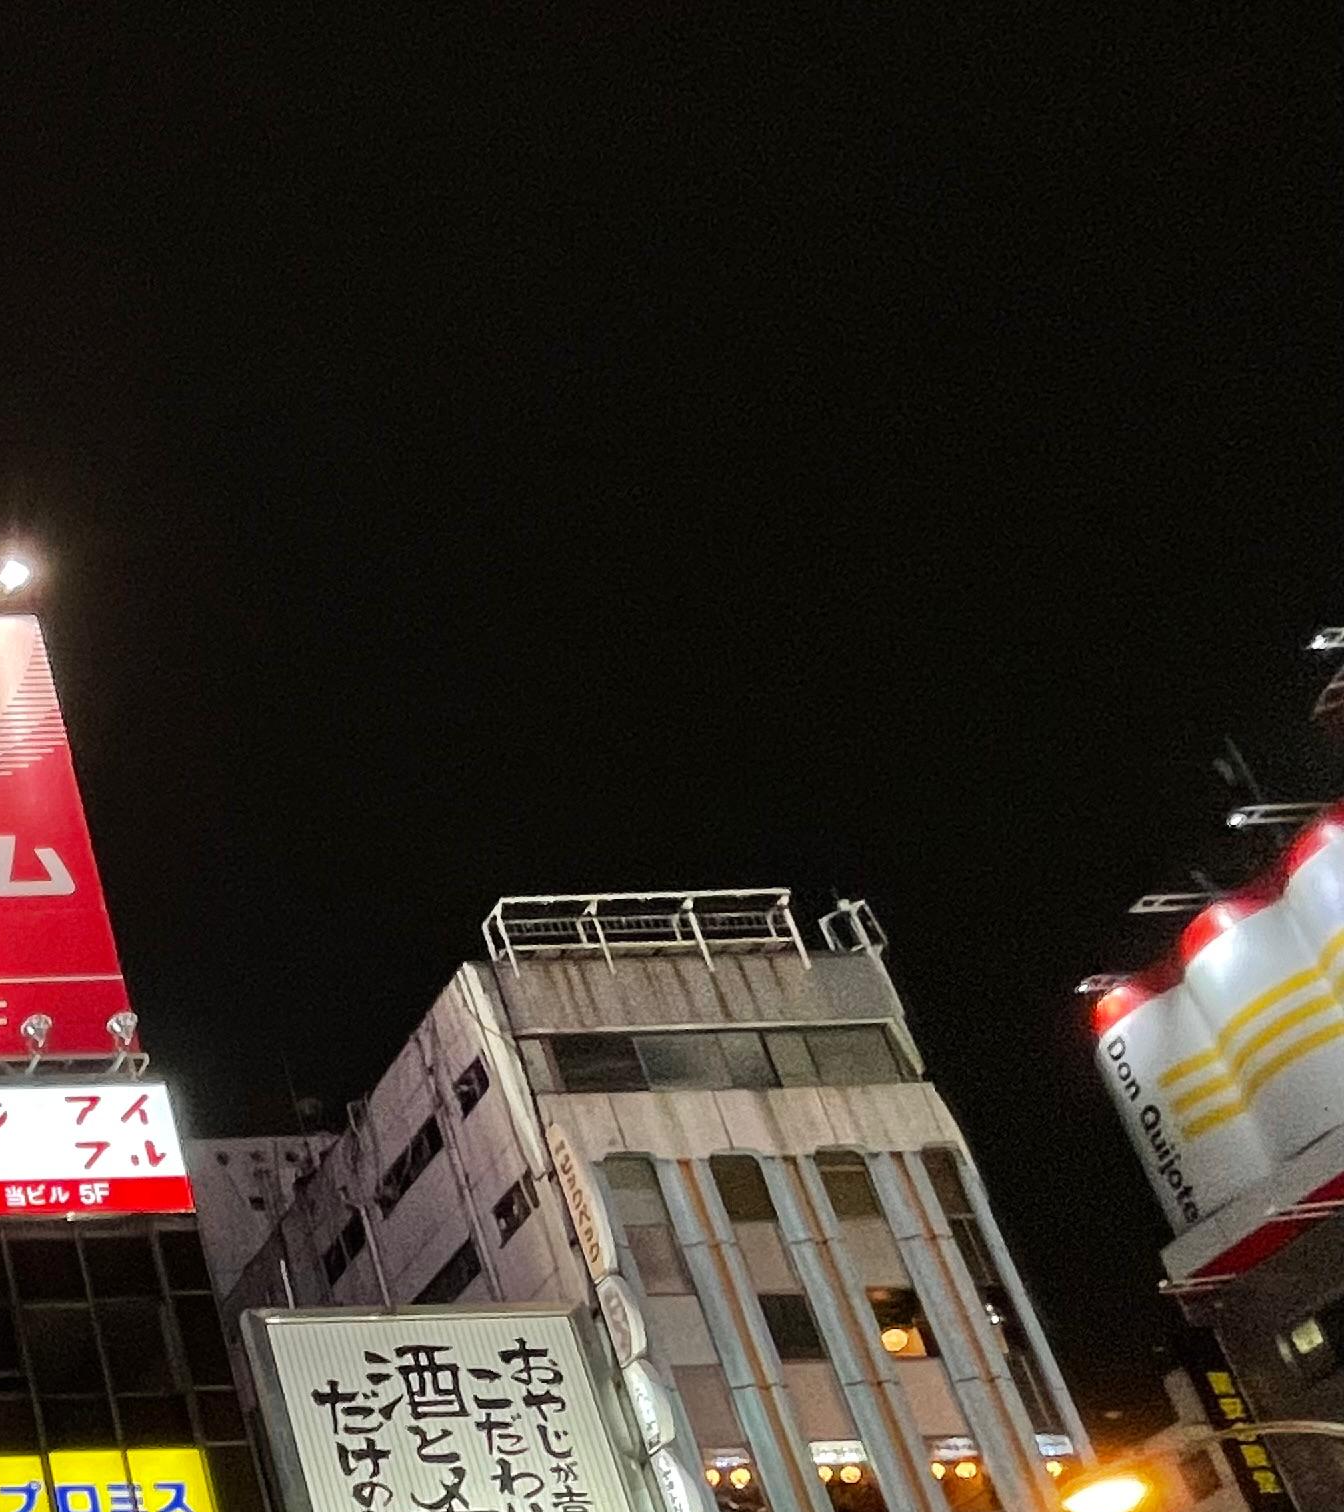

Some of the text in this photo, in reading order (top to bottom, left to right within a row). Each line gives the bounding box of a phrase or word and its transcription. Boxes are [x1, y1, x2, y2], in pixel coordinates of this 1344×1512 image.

[1106, 1036, 1200, 1226] Don Quijote
[79, 1183, 110, 1204] 5F
